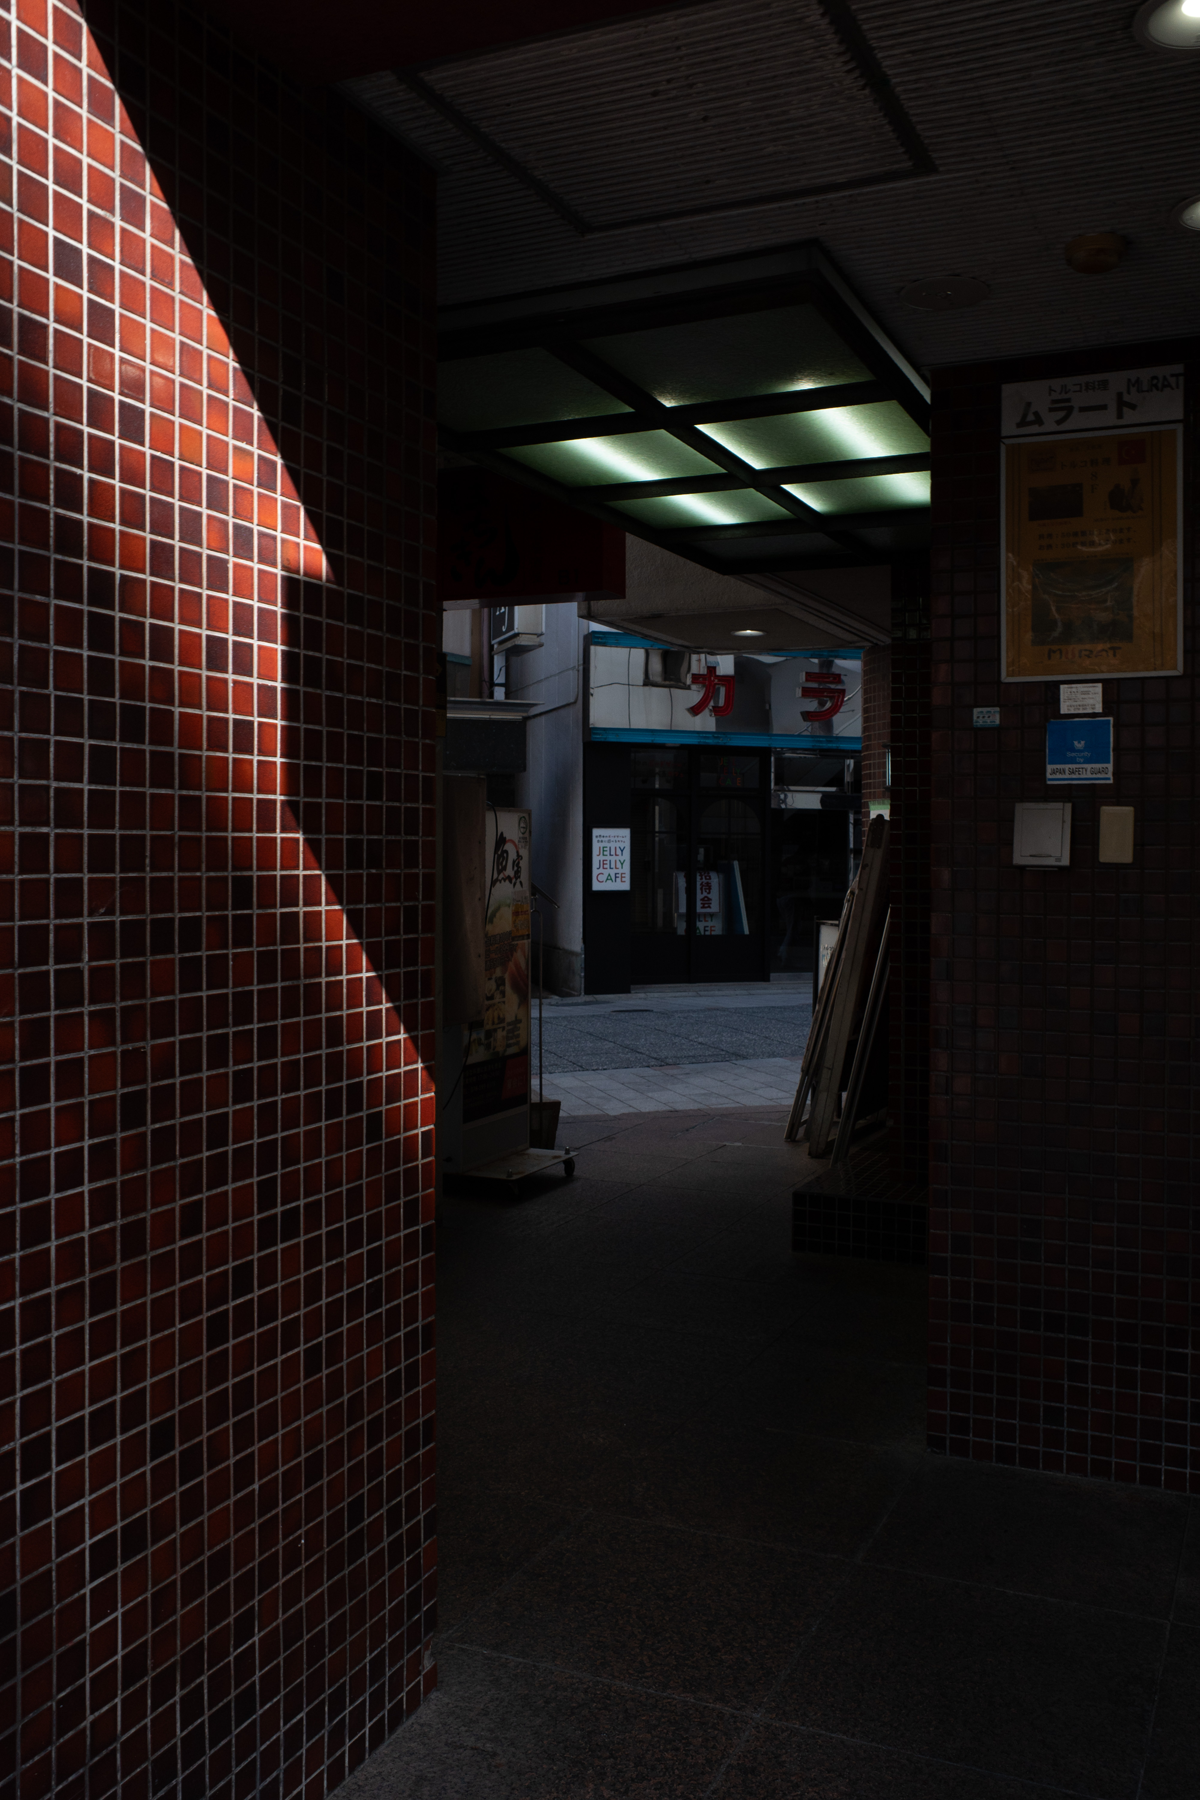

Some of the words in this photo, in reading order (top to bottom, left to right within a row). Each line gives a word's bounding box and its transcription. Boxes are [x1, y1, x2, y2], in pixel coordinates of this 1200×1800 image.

[1048, 379, 1110, 396] トルコ料理
[1126, 373, 1185, 395] MURAT
[1015, 391, 1138, 429] ムラート
[1060, 457, 1112, 471] トルコ料理
[1047, 646, 1122, 661] MURAT
[1049, 767, 1067, 776] JAPAN
[1067, 767, 1088, 776] SAFETY
[1090, 766, 1109, 775] GUARD
[596, 846, 626, 857] JELLY
[596, 859, 626, 870] JELLY
[596, 872, 627, 883] CAFE
